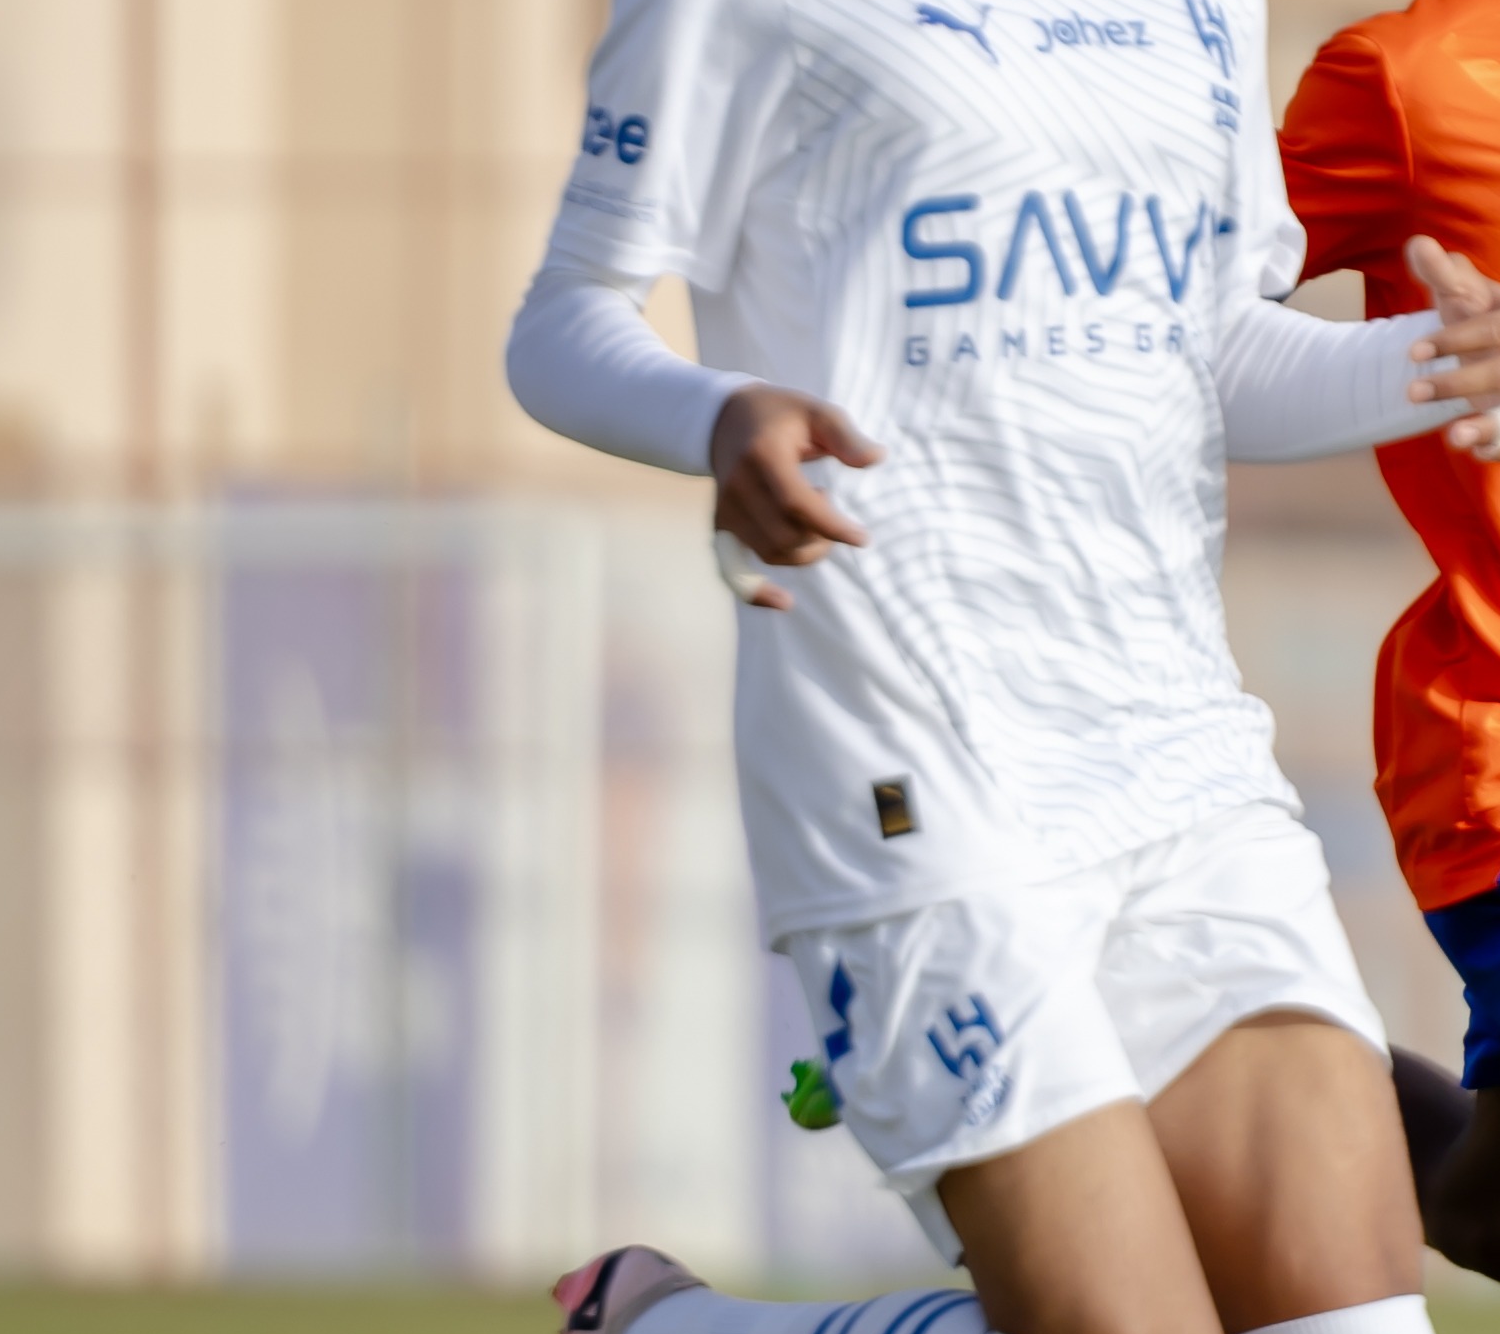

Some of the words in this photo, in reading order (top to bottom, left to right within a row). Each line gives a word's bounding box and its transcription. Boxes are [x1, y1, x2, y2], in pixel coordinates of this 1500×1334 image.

[1033, 10, 1154, 53] jahez
[902, 189, 1237, 309] SAVV
[904, 323, 1106, 367] GAMES
[1135, 321, 1201, 354] GR
